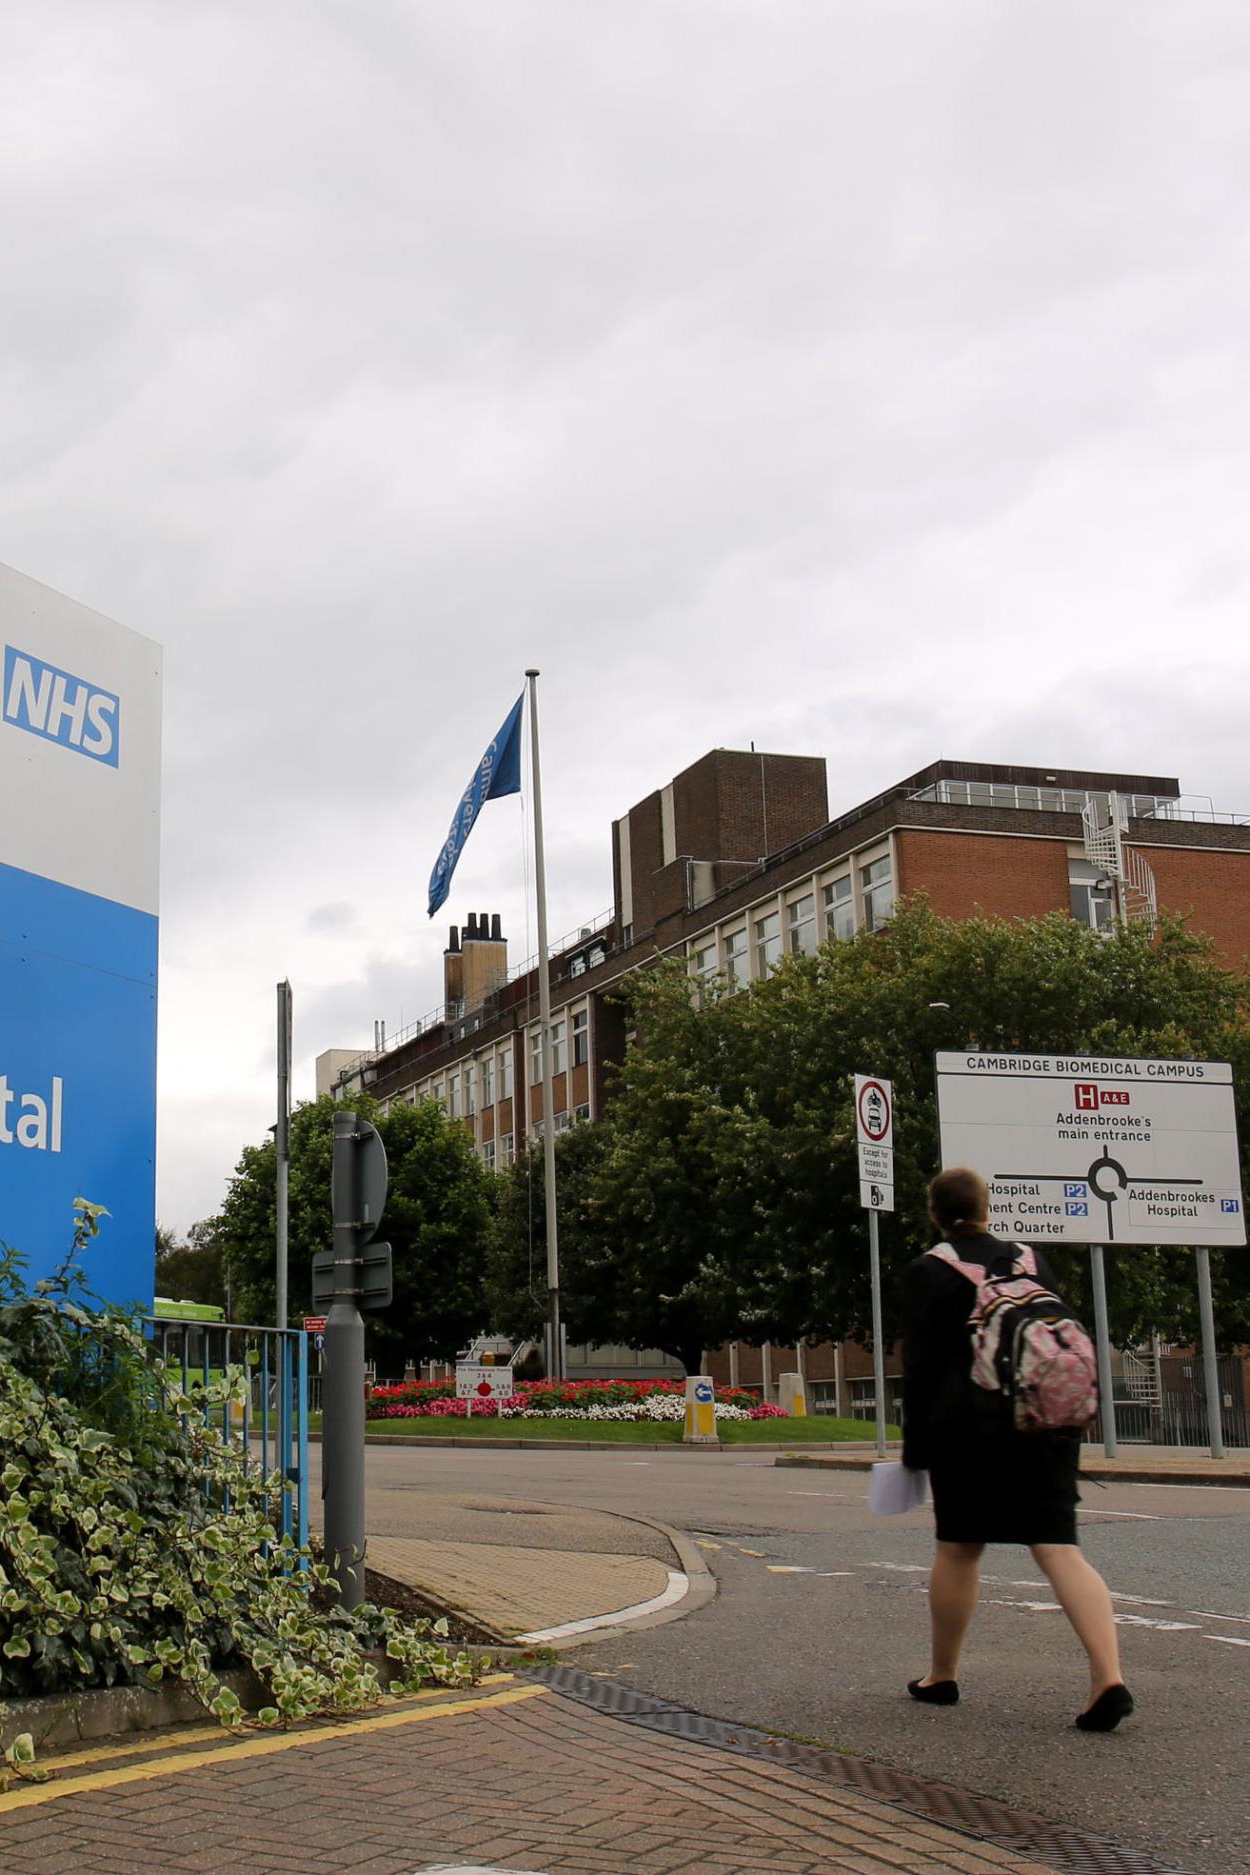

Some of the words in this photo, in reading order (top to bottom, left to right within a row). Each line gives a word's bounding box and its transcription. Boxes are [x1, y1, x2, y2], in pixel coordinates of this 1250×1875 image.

[5, 656, 117, 757] NHS
[966, 1057, 1050, 1072] CAMBRIDGE
[1056, 1061, 1141, 1076] BIOMEDICAL
[1147, 1064, 1204, 1078] CAMPUS
[1078, 1087, 1095, 1107] H
[1056, 1112, 1151, 1127] Addenbrooke's
[1058, 1128, 1089, 1139] main
[1094, 1129, 1151, 1142] entrance
[1066, 1184, 1085, 1197] P2
[1129, 1189, 1215, 1203] Addenbrookes
[1018, 1202, 1061, 1215] Centre
[1067, 1203, 1086, 1215] P2
[1147, 1204, 1198, 1217] Hospital
[1223, 1200, 1237, 1212] P1
[1014, 1220, 1065, 1233] Quarter
